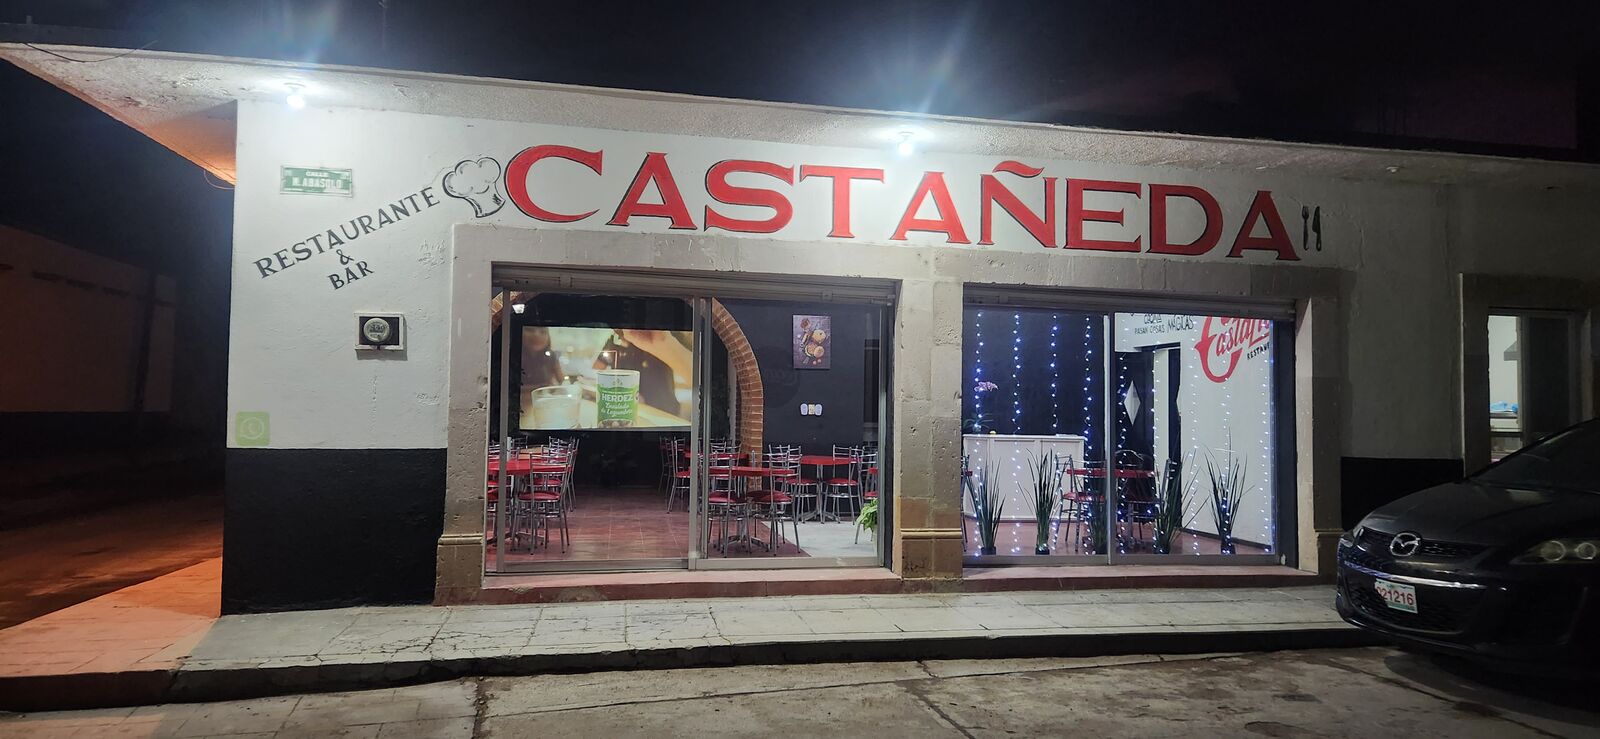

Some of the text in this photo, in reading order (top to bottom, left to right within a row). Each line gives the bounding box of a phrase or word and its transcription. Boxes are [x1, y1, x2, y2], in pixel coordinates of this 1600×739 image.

[503, 144, 1300, 261] CASTAÑEDA
[254, 187, 440, 278] RESTAURANTE
[336, 249, 354, 265] &
[328, 261, 374, 290] BAR
[601, 393, 634, 402] HERDEZ
